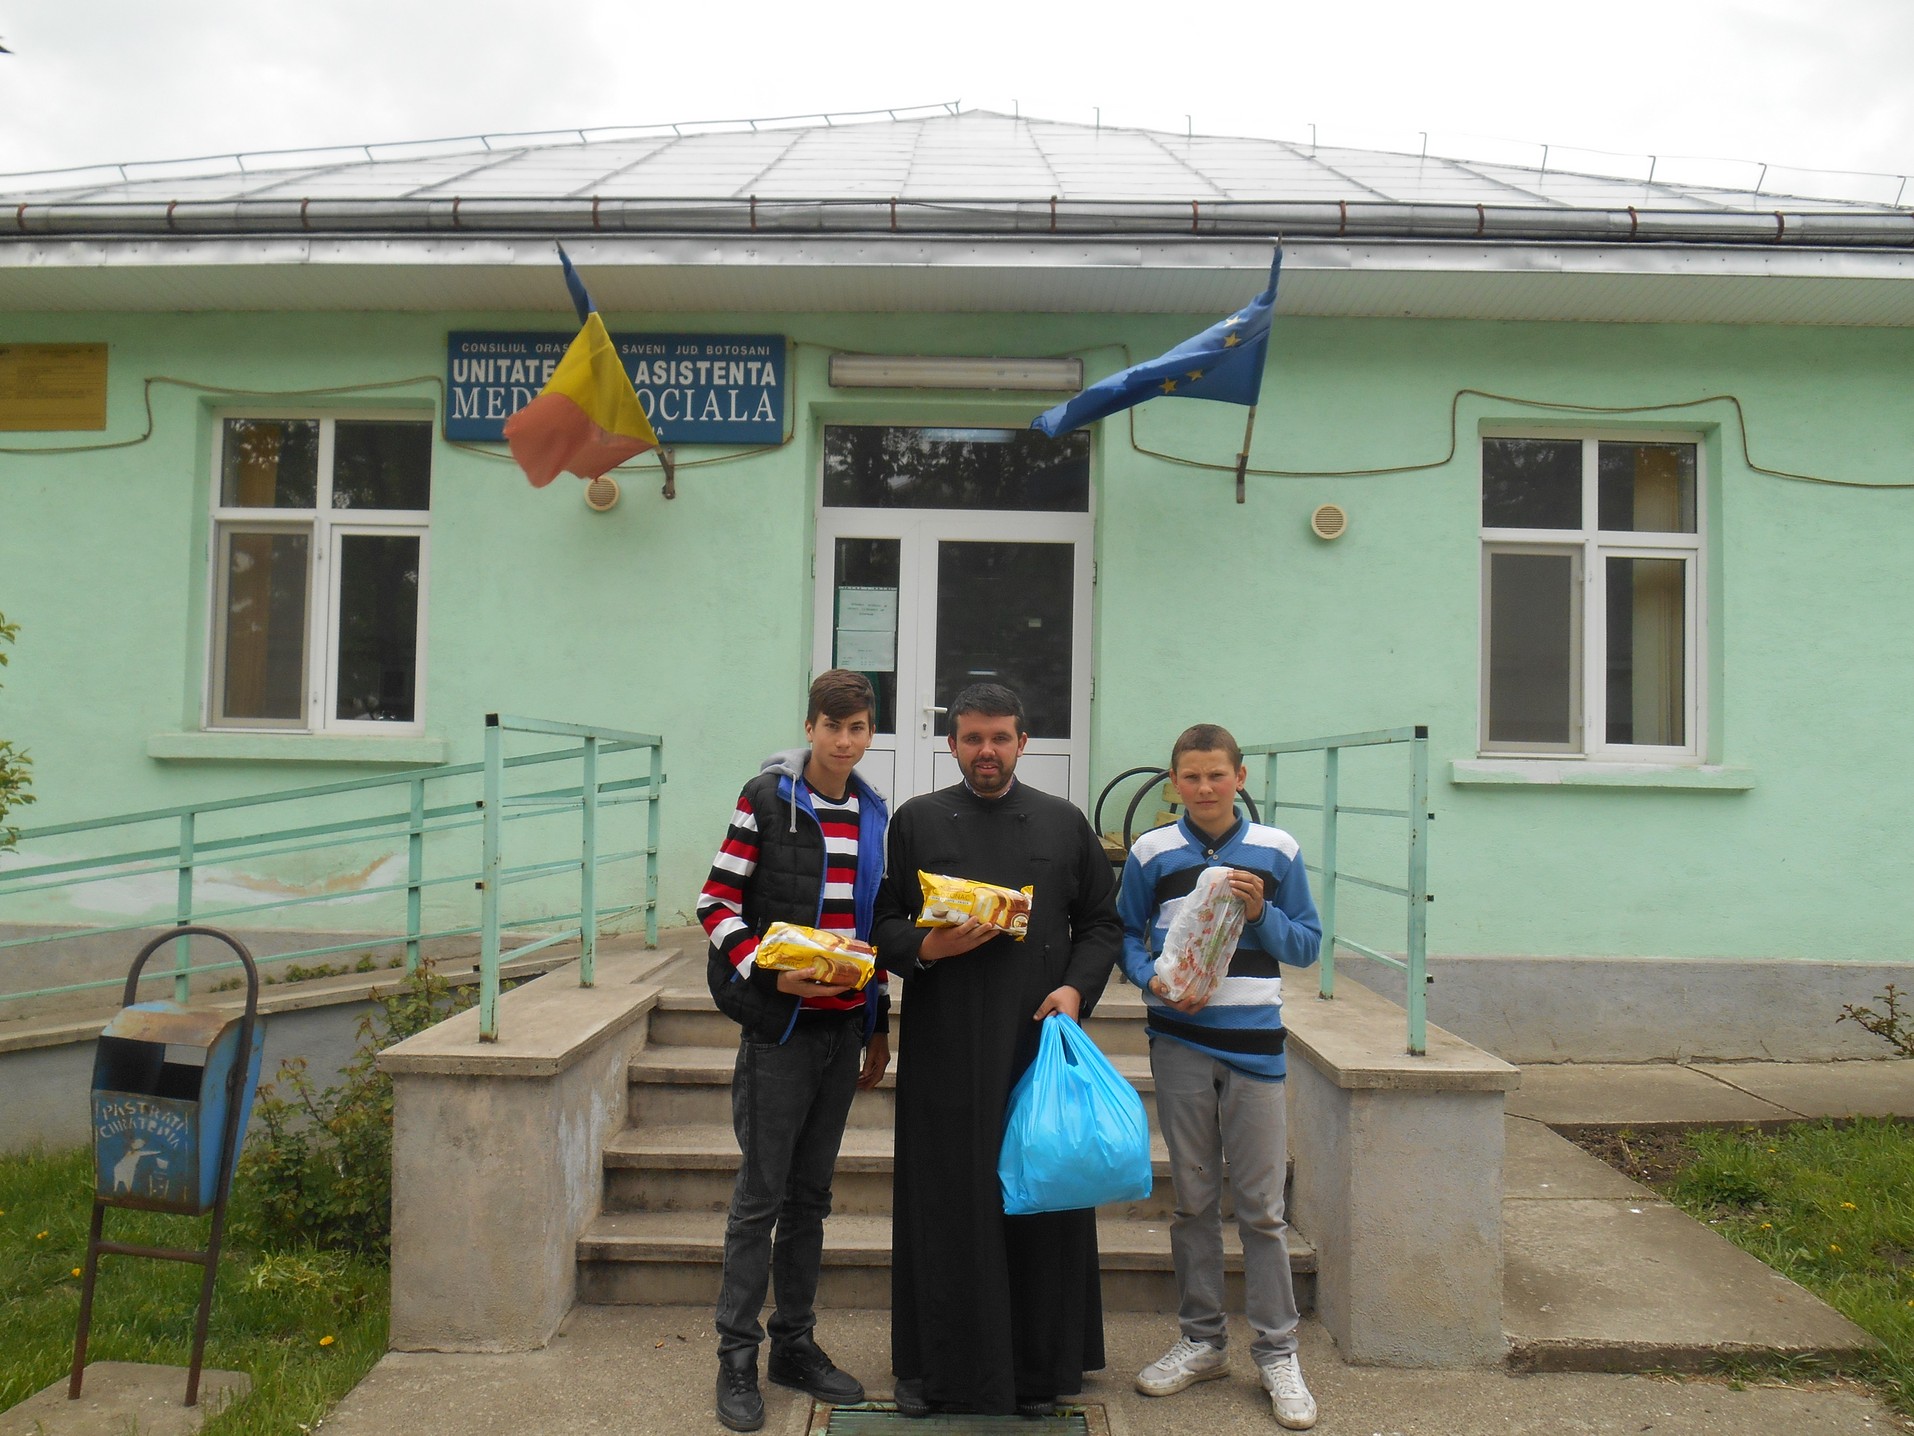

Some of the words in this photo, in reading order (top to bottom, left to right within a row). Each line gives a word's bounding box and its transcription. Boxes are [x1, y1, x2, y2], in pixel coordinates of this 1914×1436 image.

[461, 342, 528, 354] CONSILIUL
[535, 343, 570, 354] ORAS
[622, 344, 666, 355] SAVENI
[706, 345, 770, 356] BOTOSANI
[452, 359, 556, 383] UNITATE
[635, 360, 776, 386] ASISTENTA
[451, 386, 543, 419] MED
[635, 388, 776, 422] OCIALA
